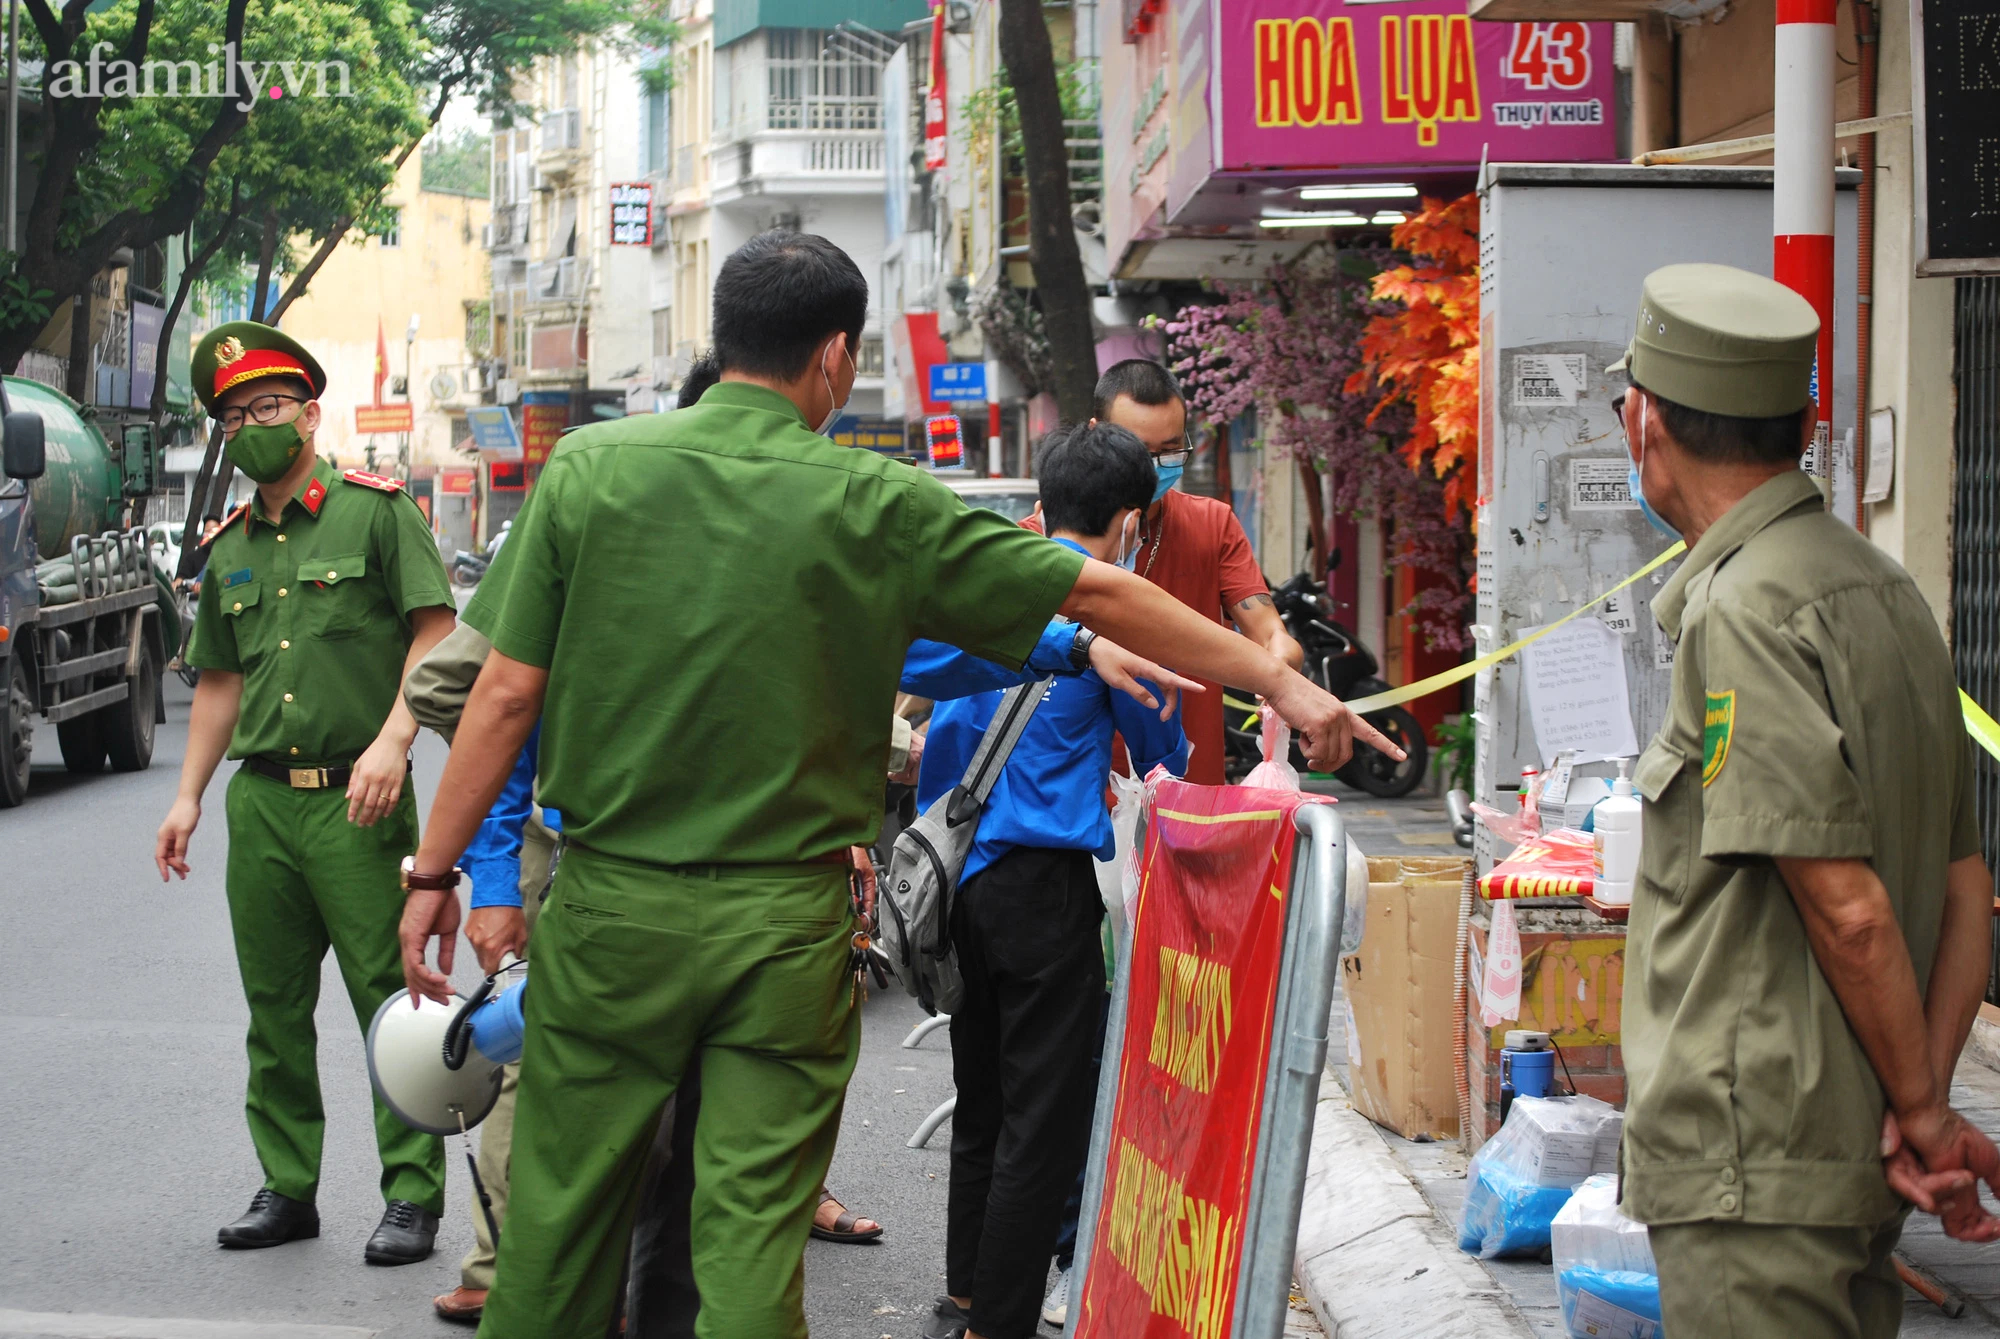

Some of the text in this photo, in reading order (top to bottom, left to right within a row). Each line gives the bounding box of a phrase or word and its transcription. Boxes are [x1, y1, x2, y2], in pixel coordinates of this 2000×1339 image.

[1255, 14, 1481, 146] HOA LỤA
[1508, 22, 1592, 90] 43
[1495, 98, 1602, 128] THỤY KHUÊ
